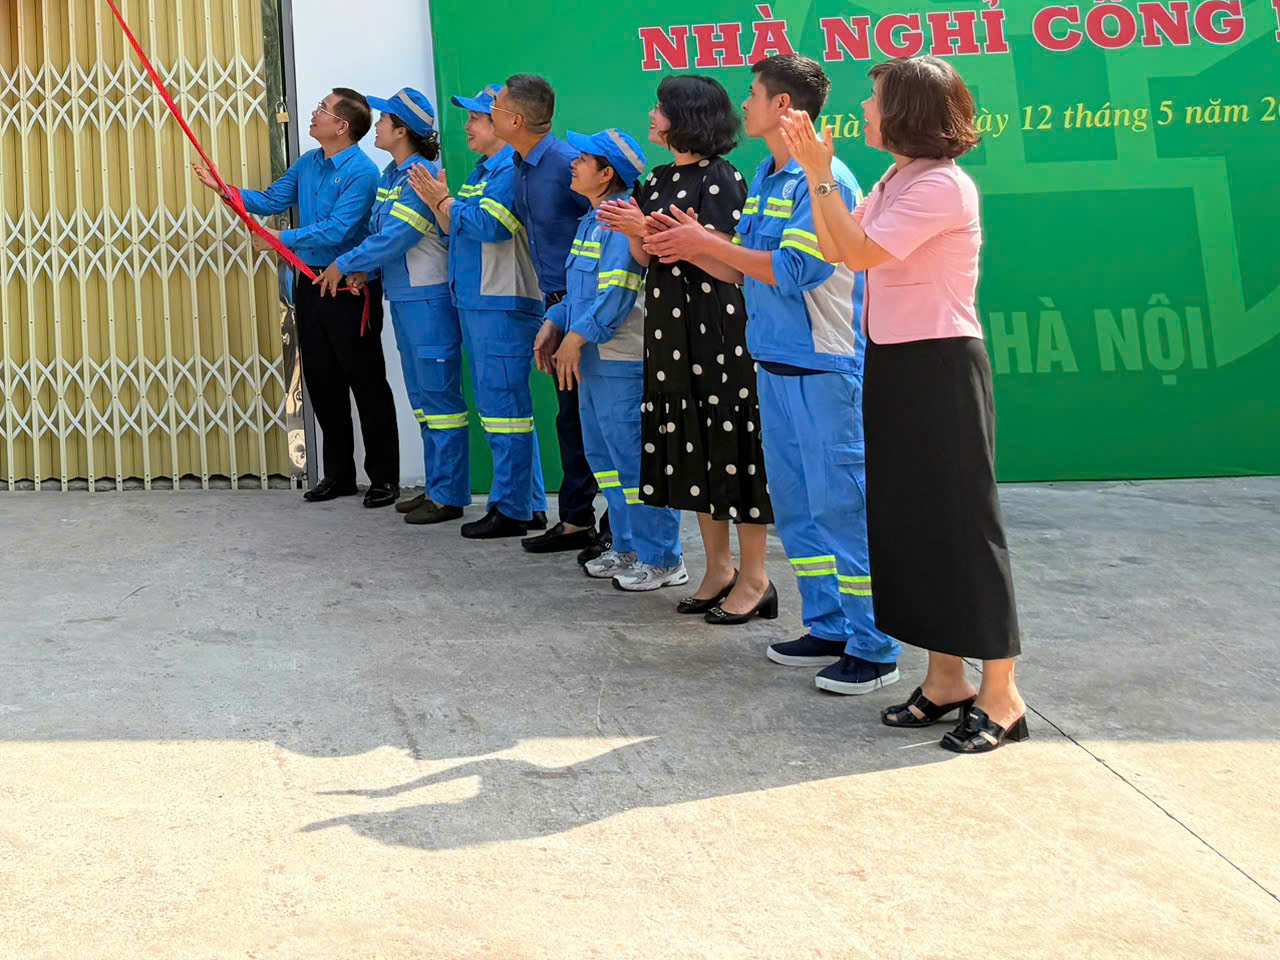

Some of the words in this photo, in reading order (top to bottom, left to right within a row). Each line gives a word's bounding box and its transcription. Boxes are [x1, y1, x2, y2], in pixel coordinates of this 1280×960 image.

[638, 4, 799, 72] NHÀ
[821, 113, 861, 139] Hà
[1021, 105, 1053, 131] 12
[1064, 102, 1150, 132] tháng
[1157, 100, 1174, 126] 5
[1185, 98, 1250, 125] năm
[1260, 96, 1280, 122] 2
[988, 296, 1080, 375] HÀ
[1093, 293, 1209, 386] NỘI
